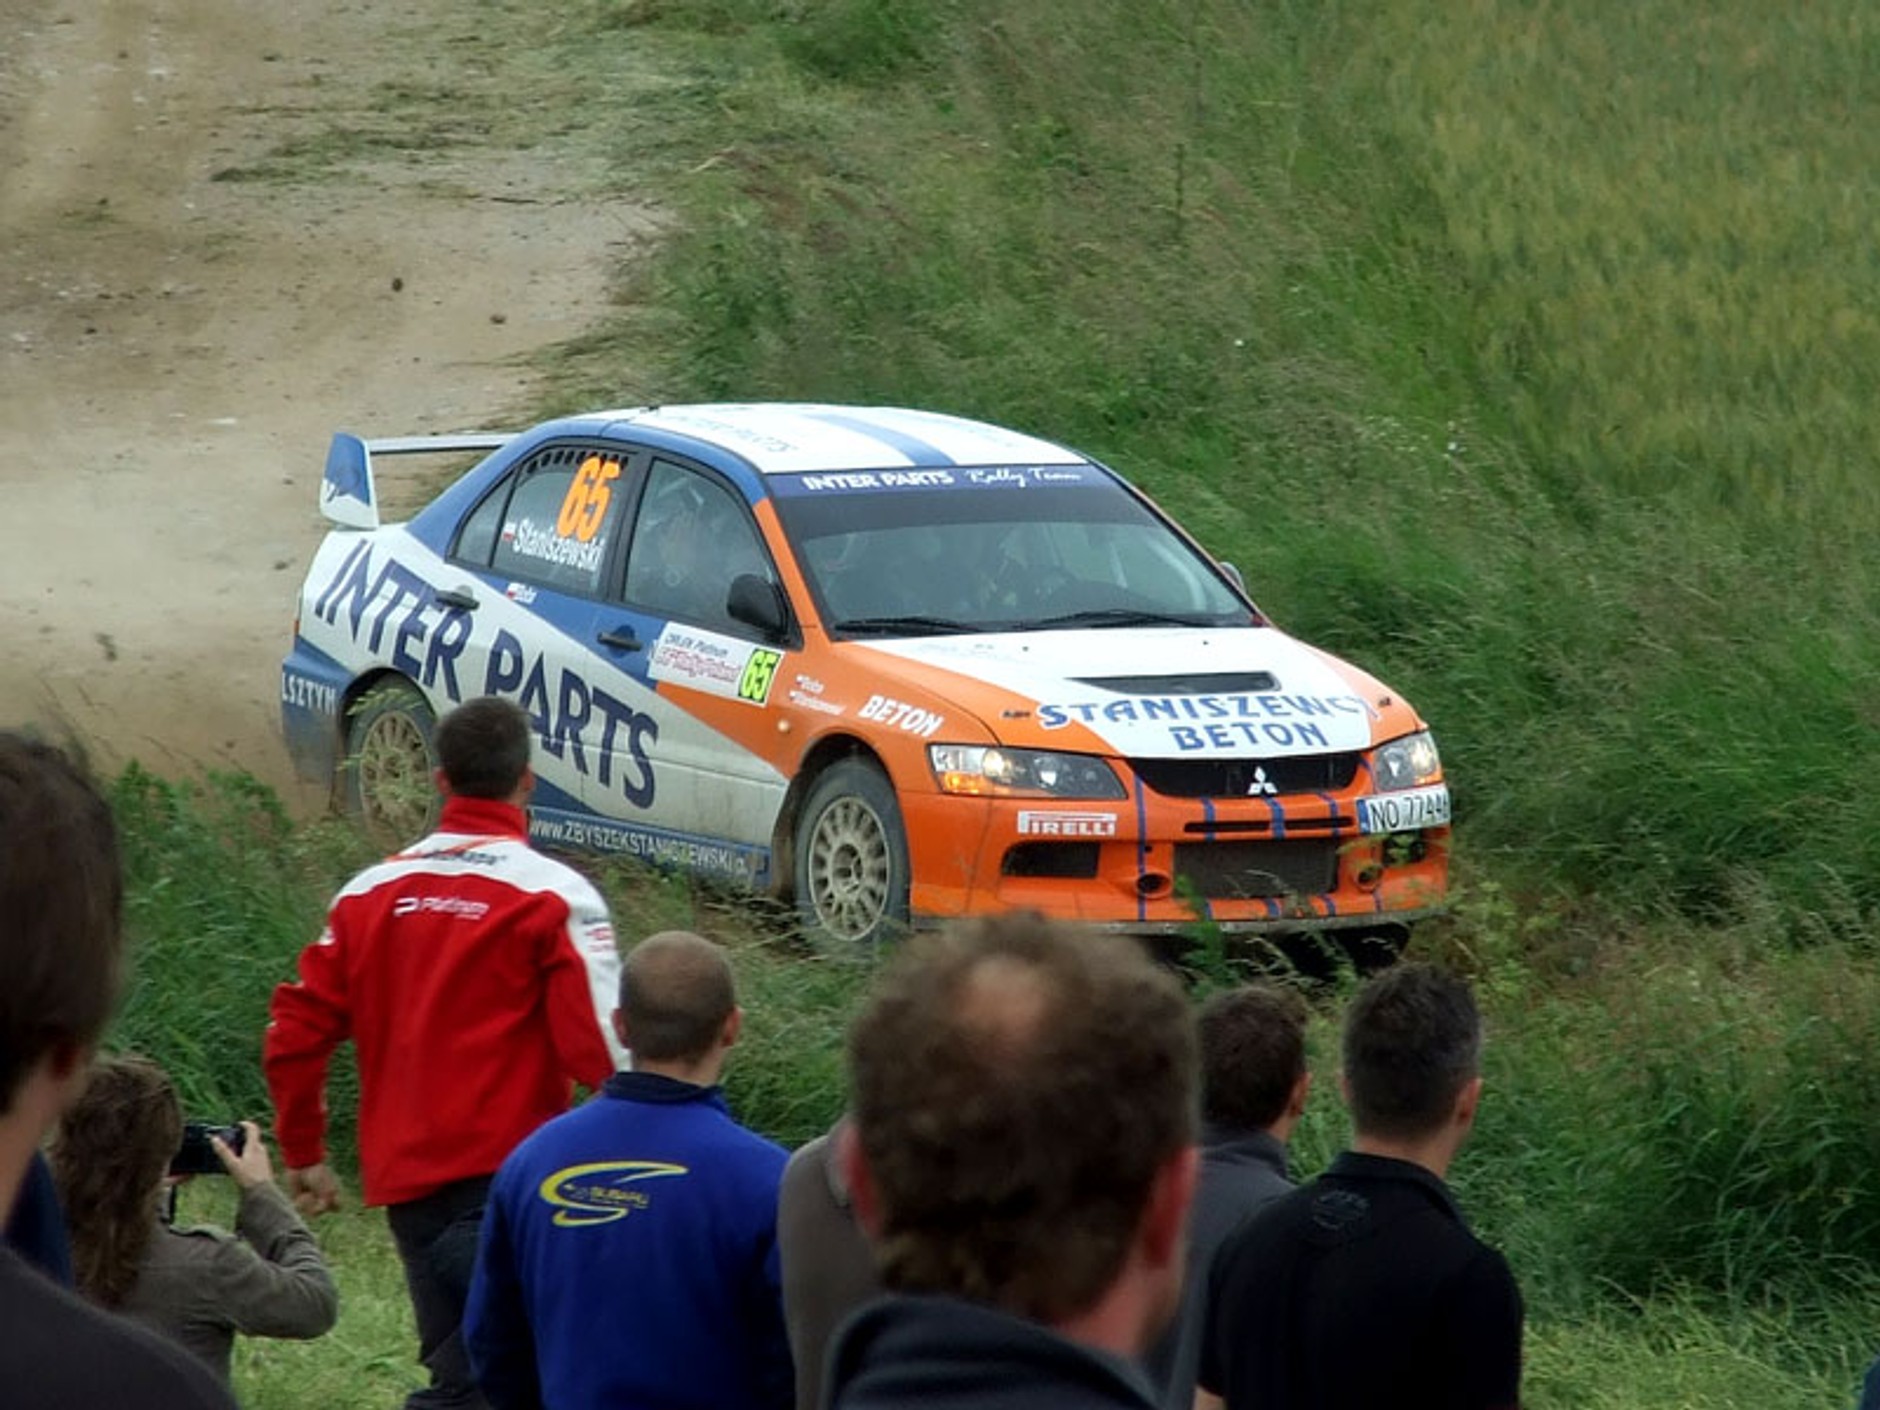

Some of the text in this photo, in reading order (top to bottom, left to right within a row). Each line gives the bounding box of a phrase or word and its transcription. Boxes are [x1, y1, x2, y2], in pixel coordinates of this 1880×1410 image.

[557, 456, 620, 542] 65
[802, 466, 1082, 490] INTER PARTS Rally Team
[512, 517, 605, 573] Staniszewski
[315, 538, 659, 810] INTER PARTS
[740, 650, 778, 701] 65
[858, 695, 945, 738] BETON
[1168, 723, 1330, 751] BETON
[1017, 810, 1117, 836] PIRELLI
[1370, 800, 1399, 830] NO
